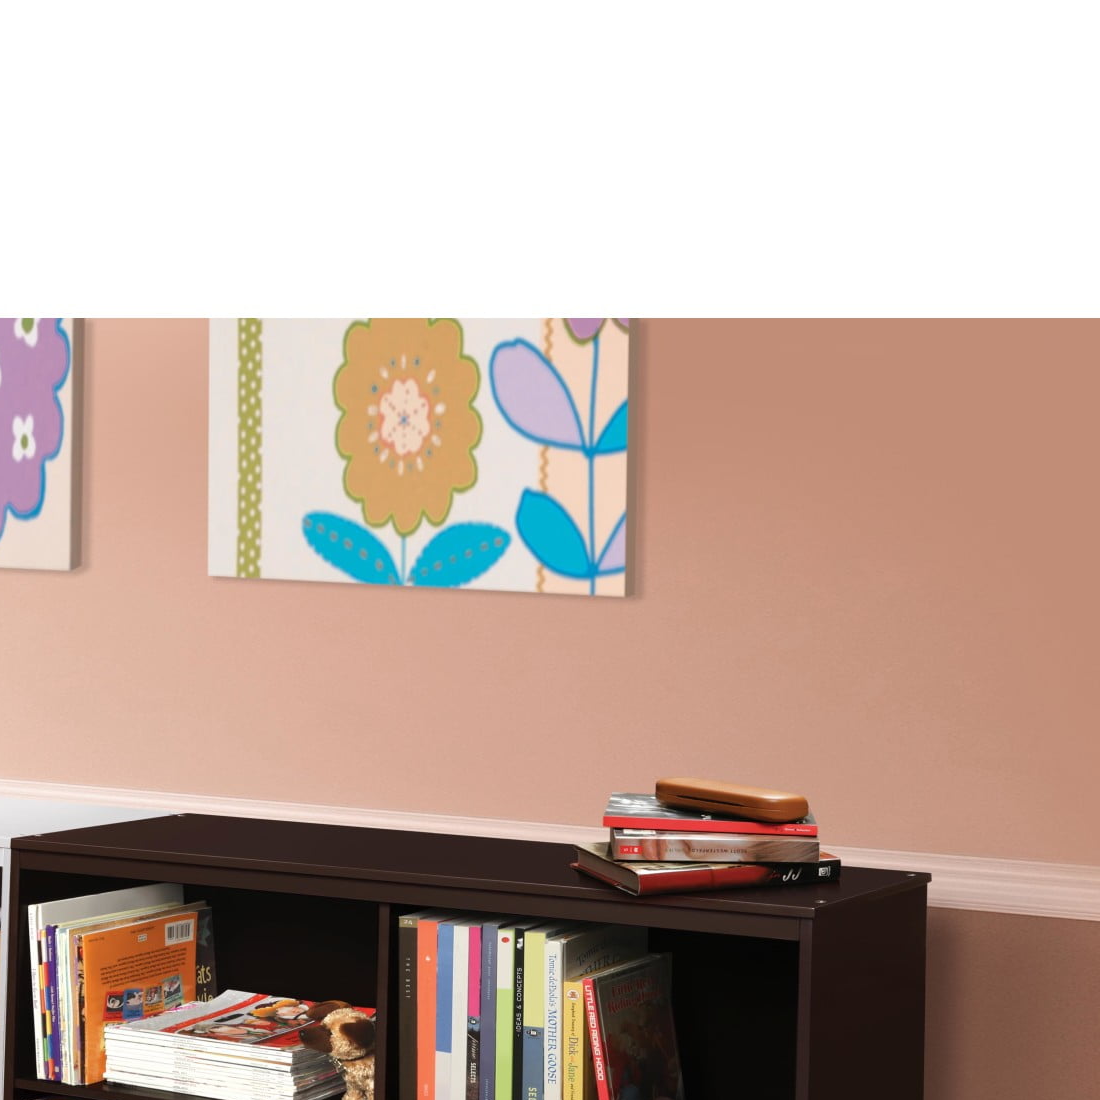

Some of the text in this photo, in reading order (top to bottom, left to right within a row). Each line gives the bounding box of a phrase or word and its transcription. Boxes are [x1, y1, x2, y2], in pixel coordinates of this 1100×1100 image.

[196, 965, 212, 984] ats
[548, 953, 557, 976] Tomie
[547, 1009, 557, 1051] MOTHER
[583, 984, 605, 1081] LITTLE RED RIDING HOOD
[568, 1037, 579, 1055] Dick
[547, 1053, 557, 1084] GOOSE
[567, 1063, 578, 1082] Jane
